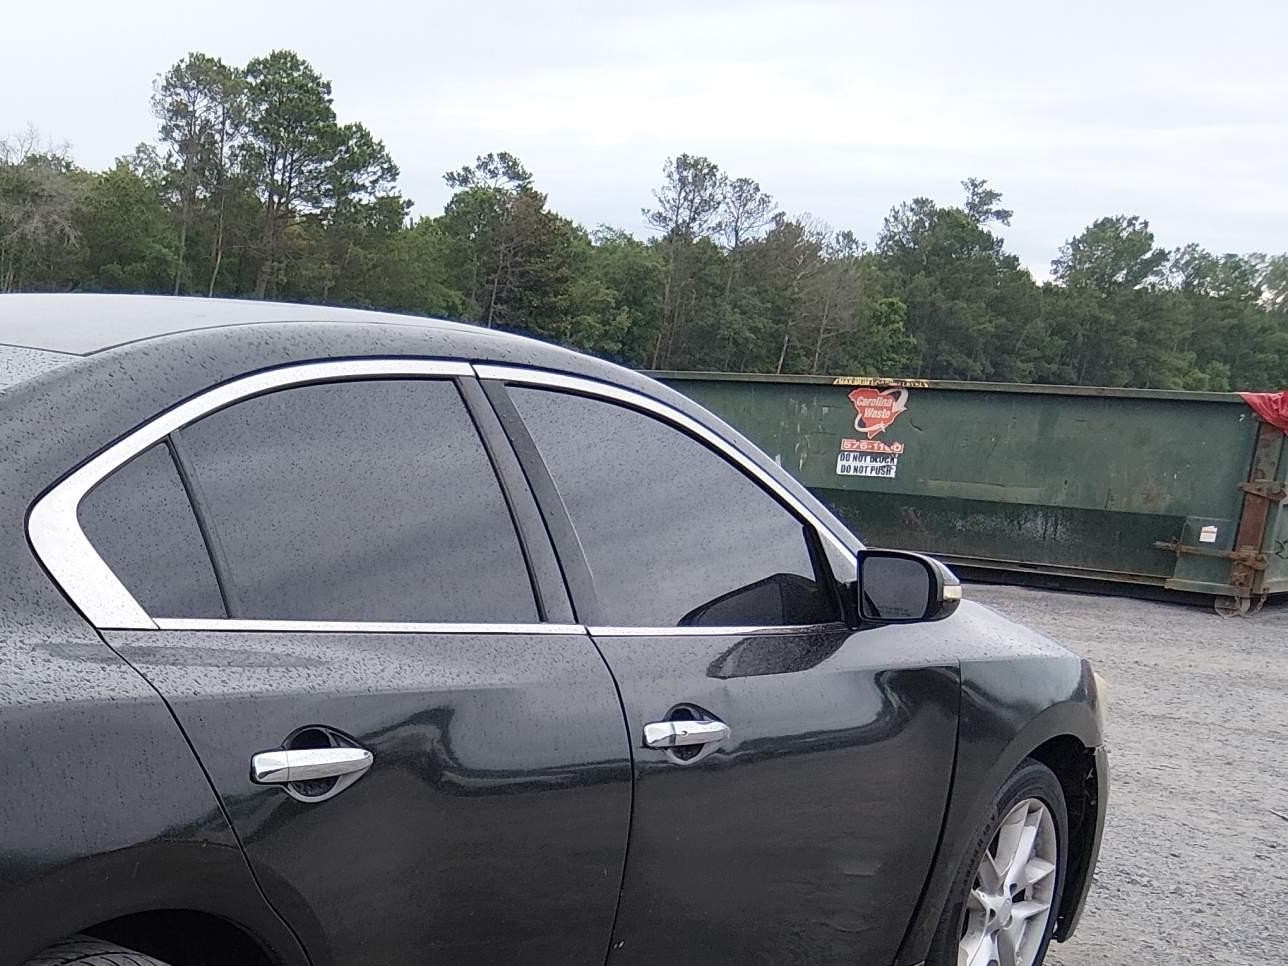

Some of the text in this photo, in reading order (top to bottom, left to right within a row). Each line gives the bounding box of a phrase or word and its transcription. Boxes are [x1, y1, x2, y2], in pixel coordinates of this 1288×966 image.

[857, 396, 892, 407] Carolina
[864, 407, 891, 418] Waste
[840, 453, 851, 462] DO
[852, 454, 868, 463] NOT
[840, 465, 851, 474] DO
[853, 465, 869, 474] NOT
